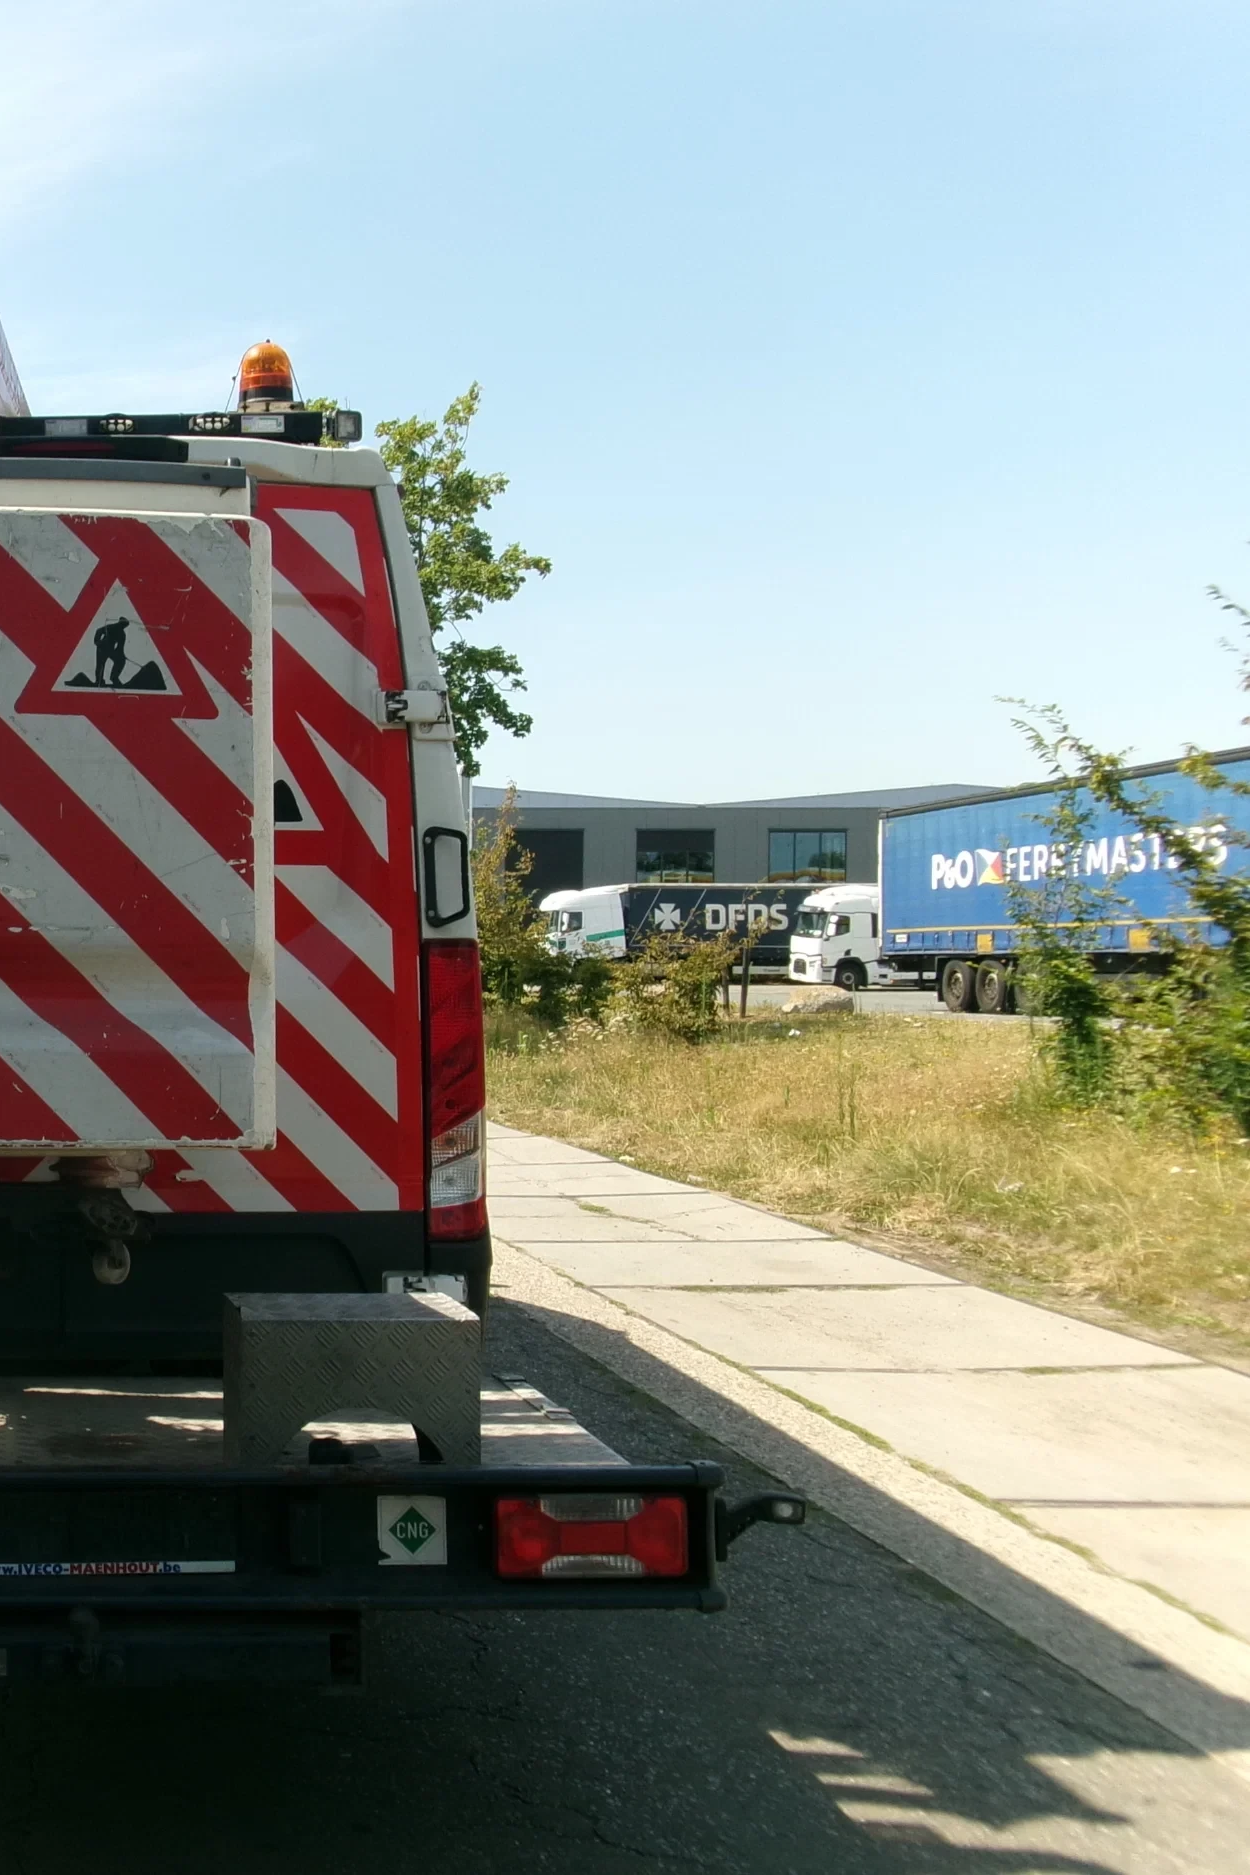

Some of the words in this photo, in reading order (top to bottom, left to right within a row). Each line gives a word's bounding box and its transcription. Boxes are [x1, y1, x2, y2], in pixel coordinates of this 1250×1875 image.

[931, 849, 974, 890] P&O
[705, 903, 789, 931] DFDS
[396, 1521, 429, 1539] CNG
